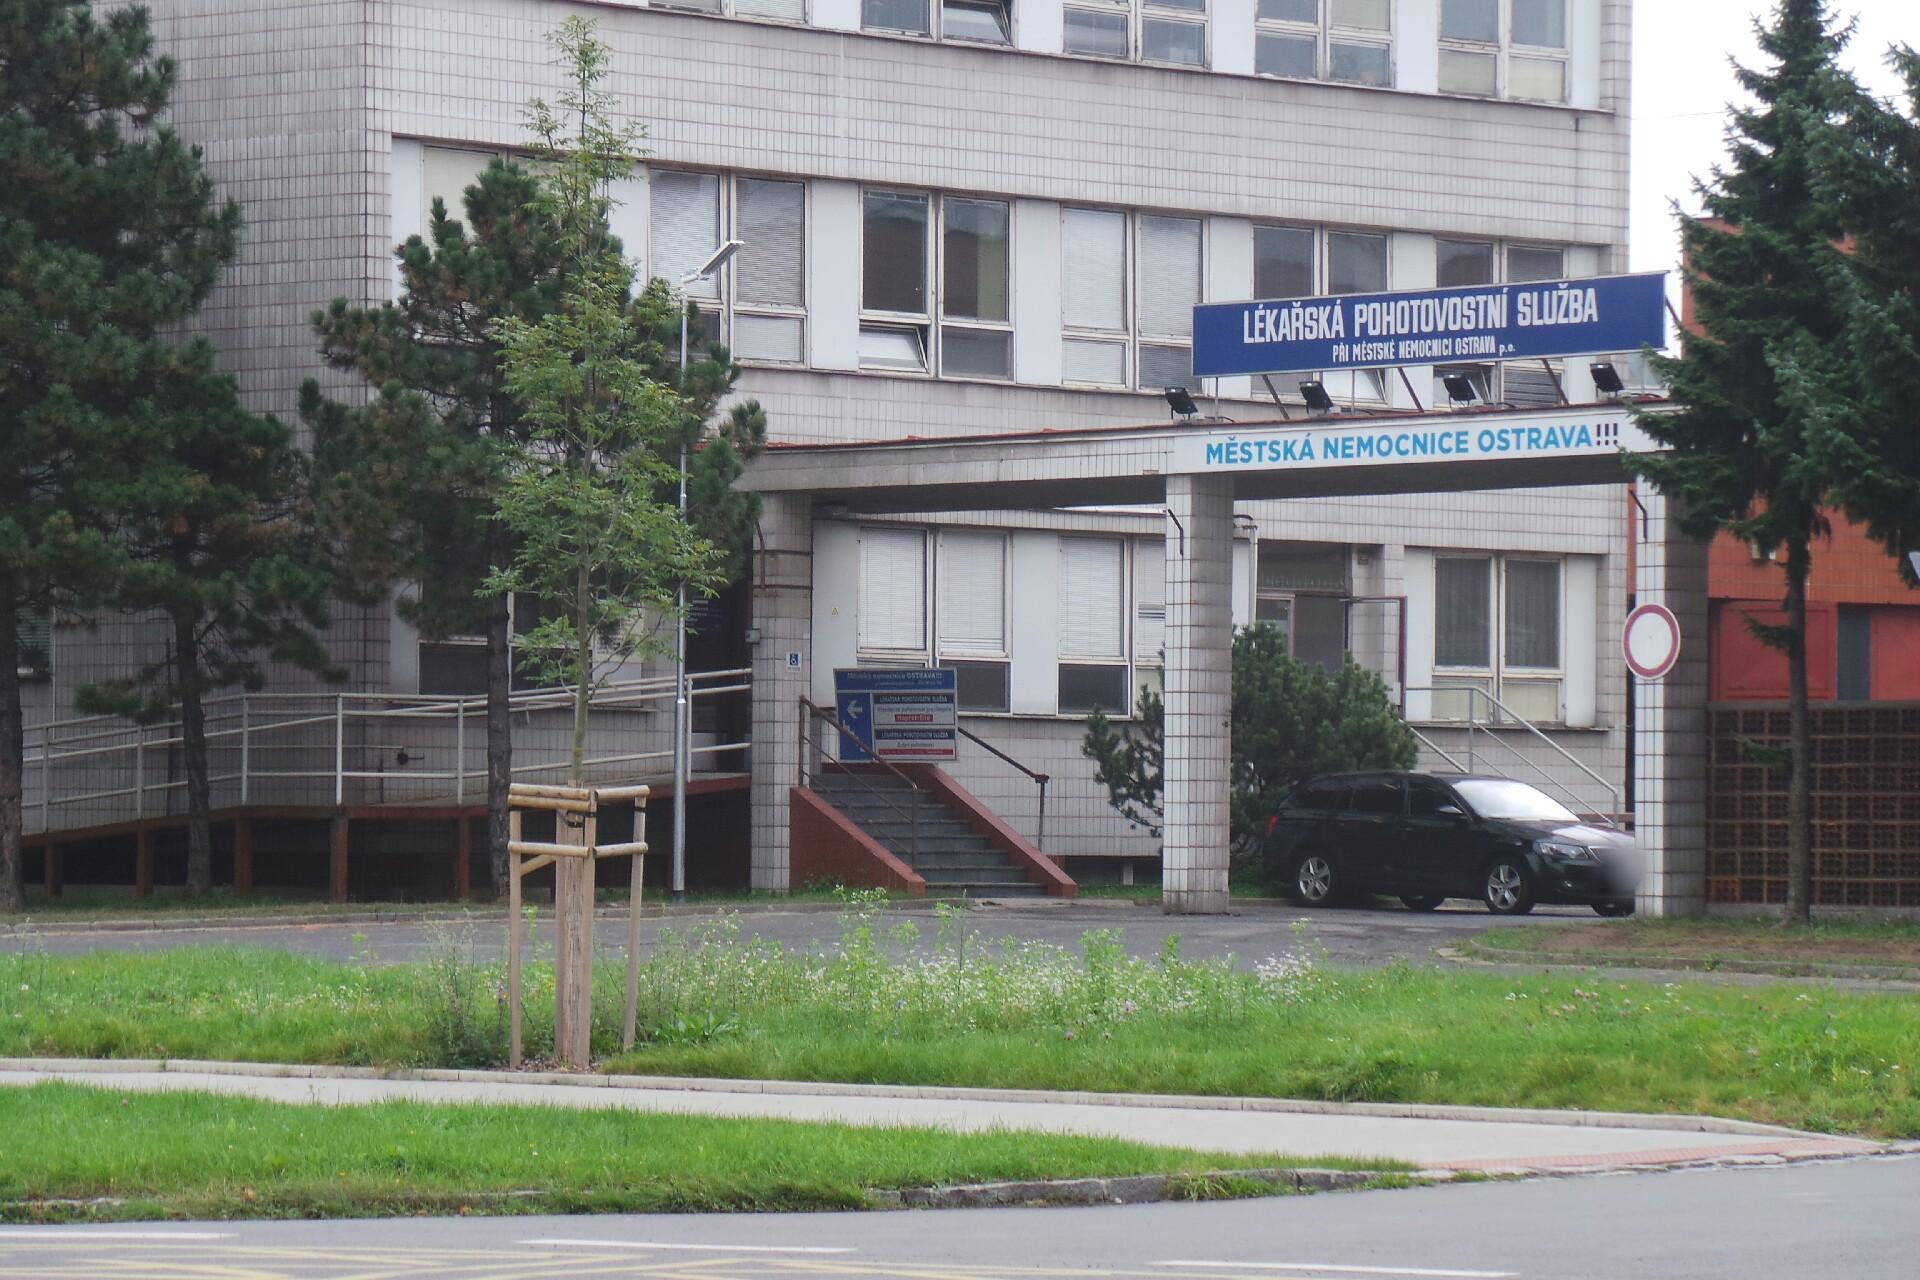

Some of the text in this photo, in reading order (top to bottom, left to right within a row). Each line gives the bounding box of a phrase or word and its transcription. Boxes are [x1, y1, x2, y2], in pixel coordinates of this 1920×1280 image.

[1243, 282, 1599, 344] LÉKAŘSKÁ POHOTOVOSTNÍ SLUŽBA
[1332, 341, 1349, 363] PŘI
[1399, 338, 1452, 359] NEMOCNICI
[1455, 335, 1496, 355] OSTRAVA
[1499, 343, 1516, 357] p.o.
[1206, 432, 1315, 465] MĚSTSKÁ
[1323, 430, 1469, 460] NEMOCNICE
